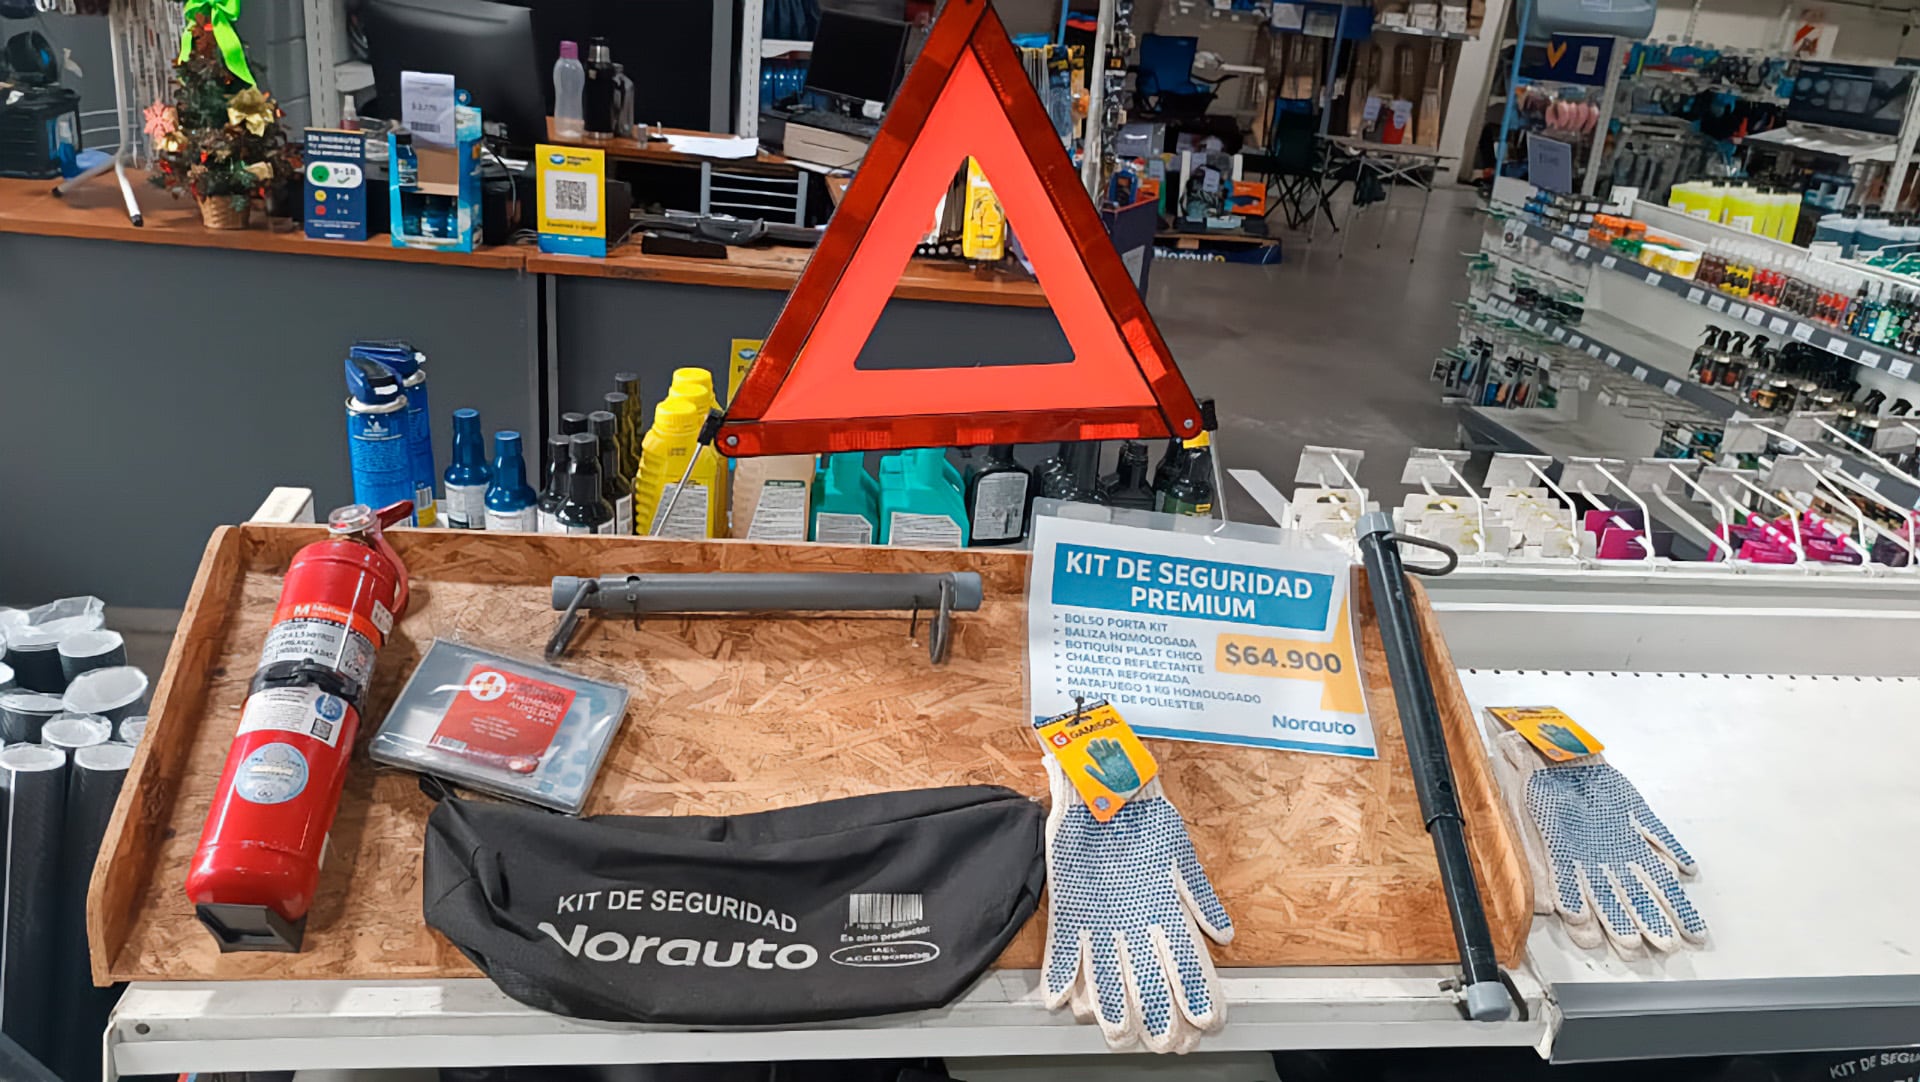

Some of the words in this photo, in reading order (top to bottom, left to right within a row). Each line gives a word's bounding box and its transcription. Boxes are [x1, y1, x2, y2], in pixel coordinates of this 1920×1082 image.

[1065, 551, 1111, 578] KIT
[1116, 556, 1152, 582] DE
[1158, 562, 1313, 600] SEGURIDAD
[1131, 585, 1257, 620] PREMIUM
[1064, 613, 1104, 626] BOLSO
[1107, 616, 1146, 630] PORTA
[1149, 622, 1168, 632] KIT
[1065, 627, 1107, 639] BALIZA
[1109, 631, 1197, 648] HOMOLOGADA
[1065, 640, 1123, 654] BOTIQUÍN
[1126, 646, 1161, 657] PLAST
[1166, 650, 1202, 661] CHICO
[1225, 642, 1342, 674] $64.900
[1066, 652, 1121, 665] CHALECO
[1124, 657, 1204, 674] REFLECTANTE
[1067, 664, 1114, 677] CUARTA
[1117, 669, 1190, 684] REFORZADA
[1067, 677, 1142, 692] MATAFUEGO
[1145, 684, 1150, 693] 1
[1154, 686, 1170, 695] KG
[1174, 688, 1262, 705] HOMOLOGADO
[1068, 689, 1117, 701] GUANTE
[1121, 694, 1137, 704] DE
[1141, 697, 1205, 711] POLIESTER
[1272, 714, 1356, 736] Norauto
[557, 891, 601, 914] KIT
[607, 889, 644, 910] DE
[650, 889, 798, 933] SEGURIDAD
[537, 921, 818, 970] Norauto
[1829, 1060, 1857, 1079] KIT
[1860, 1055, 1876, 1072] DE
